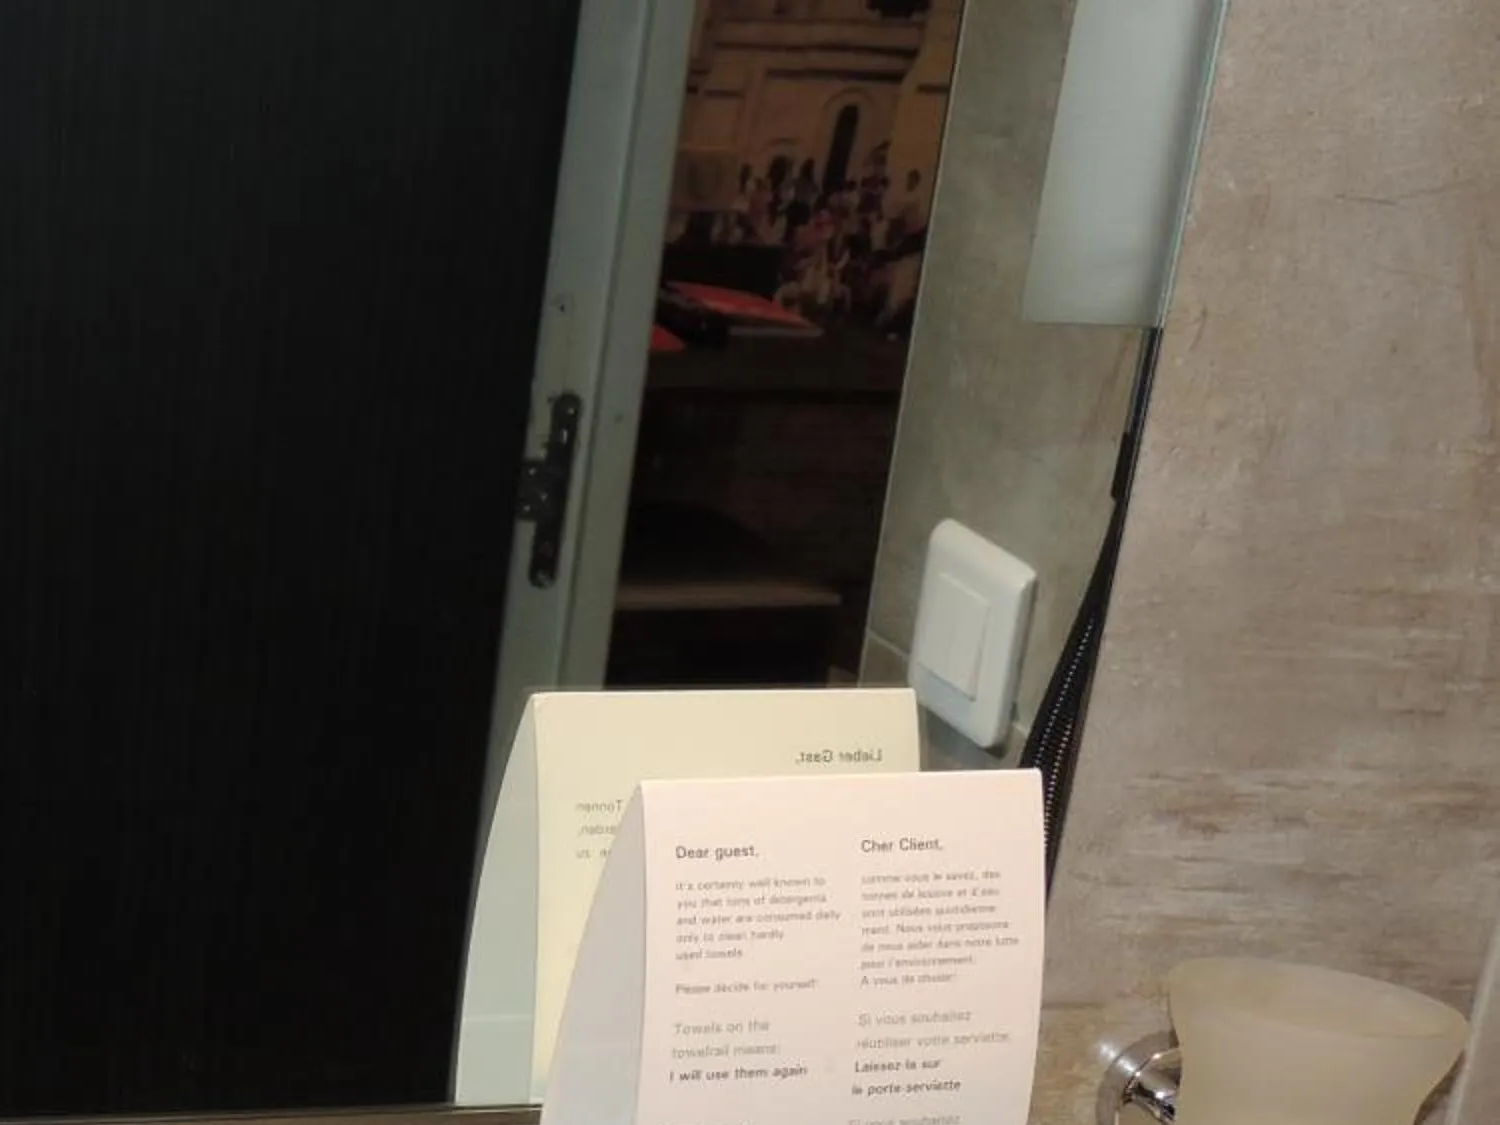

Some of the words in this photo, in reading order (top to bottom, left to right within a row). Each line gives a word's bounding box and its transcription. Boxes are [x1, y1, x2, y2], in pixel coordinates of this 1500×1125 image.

[675, 845, 709, 859] Dear
[715, 845, 759, 861] guest,
[861, 838, 893, 852] Cher
[899, 838, 943, 852] Client,
[674, 1020, 722, 1035] Towels
[726, 1021, 743, 1033] on
[748, 1018, 770, 1032] the
[875, 1012, 906, 1025] vous
[679, 1068, 702, 1081] will
[705, 1070, 729, 1081] use
[734, 1066, 768, 1080] them
[772, 1063, 808, 1080] again
